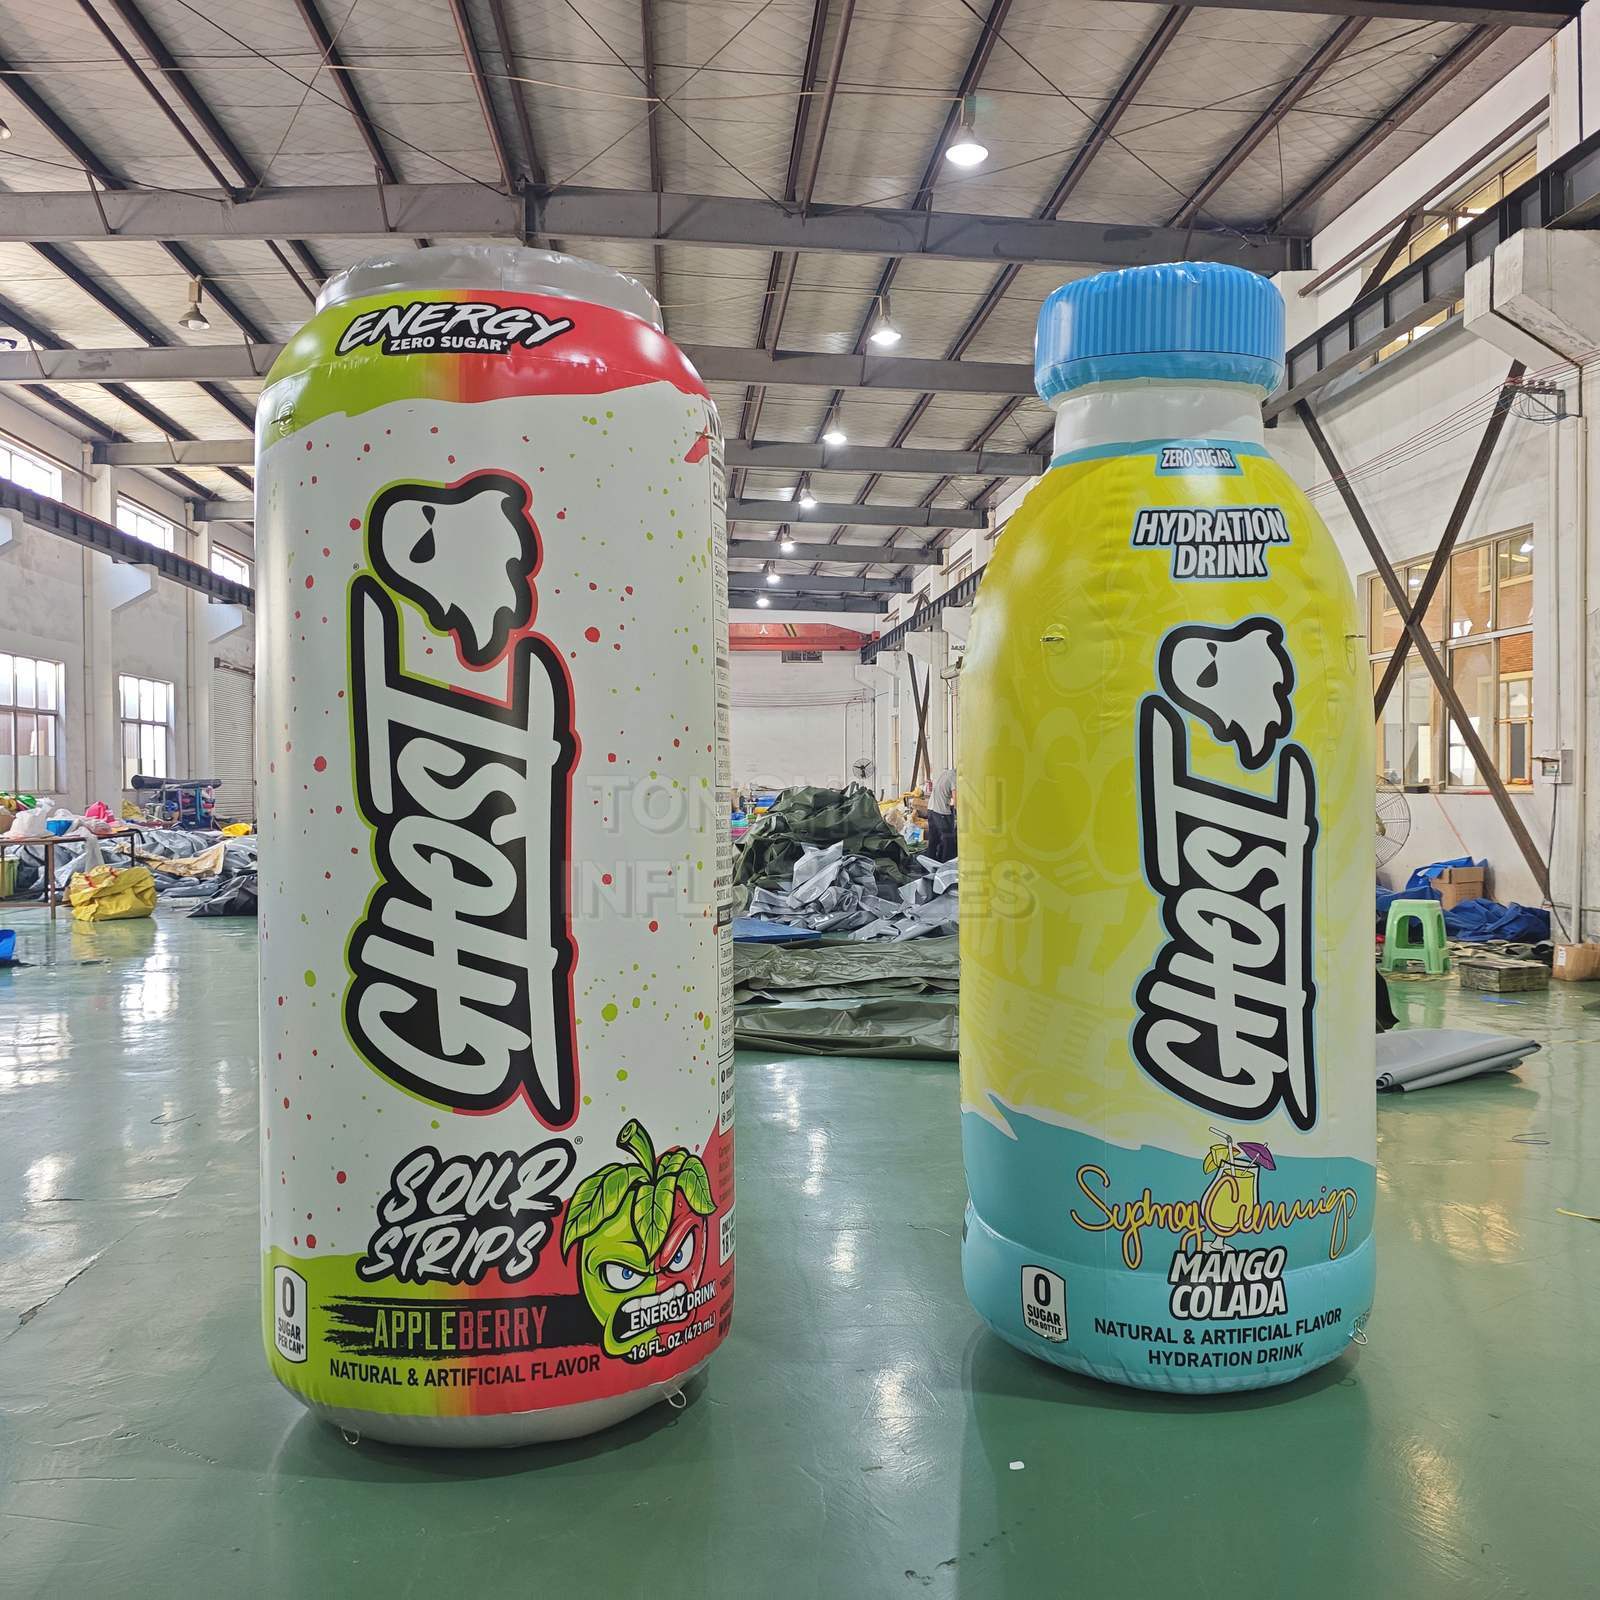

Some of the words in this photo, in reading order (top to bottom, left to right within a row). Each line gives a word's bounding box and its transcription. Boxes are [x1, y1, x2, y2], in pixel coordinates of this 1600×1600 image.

[338, 303, 571, 353] ENERGY
[390, 336, 435, 351] ZERO
[1161, 448, 1192, 468] ZERO
[1193, 448, 1235, 468] SUGAR
[1134, 510, 1289, 544] HYDRATION
[1175, 543, 1267, 577] DRINK
[350, 580, 572, 1120] GHOST
[1140, 700, 1315, 1124] GHOST
[383, 1145, 568, 1223] SOUR
[360, 1214, 546, 1279] STRIPS
[1171, 1247, 1284, 1285] MANGO
[282, 1276, 295, 1318] 0
[630, 1296, 686, 1331] ENERGY
[687, 1280, 717, 1312] DRINK
[1034, 1273, 1051, 1307] 0
[1171, 1284, 1287, 1318] COLADA
[278, 1318, 301, 1341] SUGAR
[1027, 1303, 1062, 1327] SUGAR
[1028, 1316, 1040, 1328] PER
[1094, 1317, 1179, 1344] NATURAL
[1183, 1329, 1196, 1345] &
[1200, 1322, 1293, 1345] ARTIFICIAL
[1295, 1308, 1342, 1335] FLAVOR
[278, 1332, 289, 1350] PER
[631, 1346, 646, 1361] 16
[648, 1339, 666, 1356] FL.
[667, 1332, 683, 1349] OZ.
[684, 1321, 702, 1344] (473
[703, 1311, 717, 1331] mL)
[330, 1357, 403, 1387] NATURAL
[407, 1368, 419, 1387] &
[424, 1363, 526, 1388] ARTIFICIAL
[530, 1356, 600, 1381] FLAVOR
[1148, 1348, 1253, 1368] HYDRATION
[1256, 1343, 1304, 1364] DRINK
